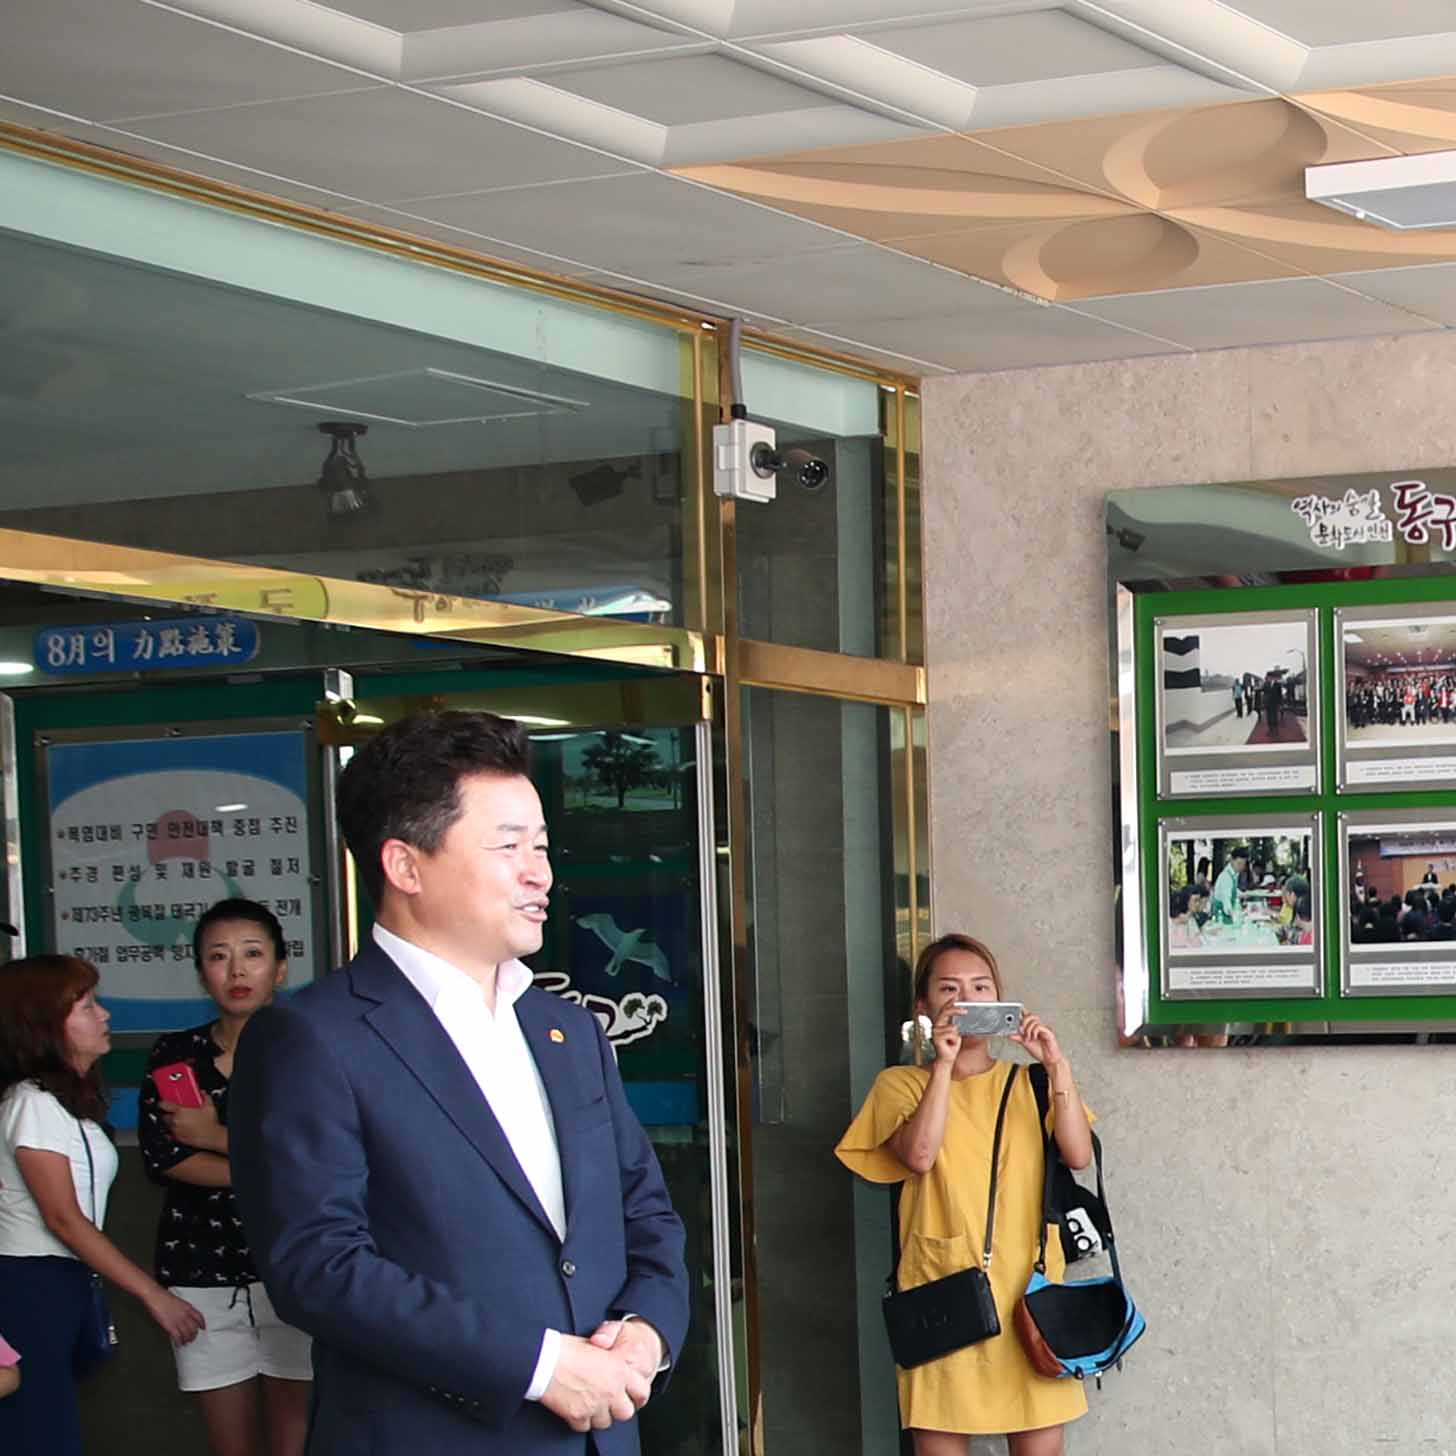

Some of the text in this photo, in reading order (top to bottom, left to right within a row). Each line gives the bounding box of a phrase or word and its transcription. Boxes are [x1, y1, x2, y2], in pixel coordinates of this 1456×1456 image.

[1292, 497, 1342, 522] 역사의
[167, 819, 224, 839] 안전대책
[233, 817, 261, 836] 중점
[270, 816, 298, 835] 추진
[155, 862, 168, 881] 및
[129, 903, 167, 922] 광복절
